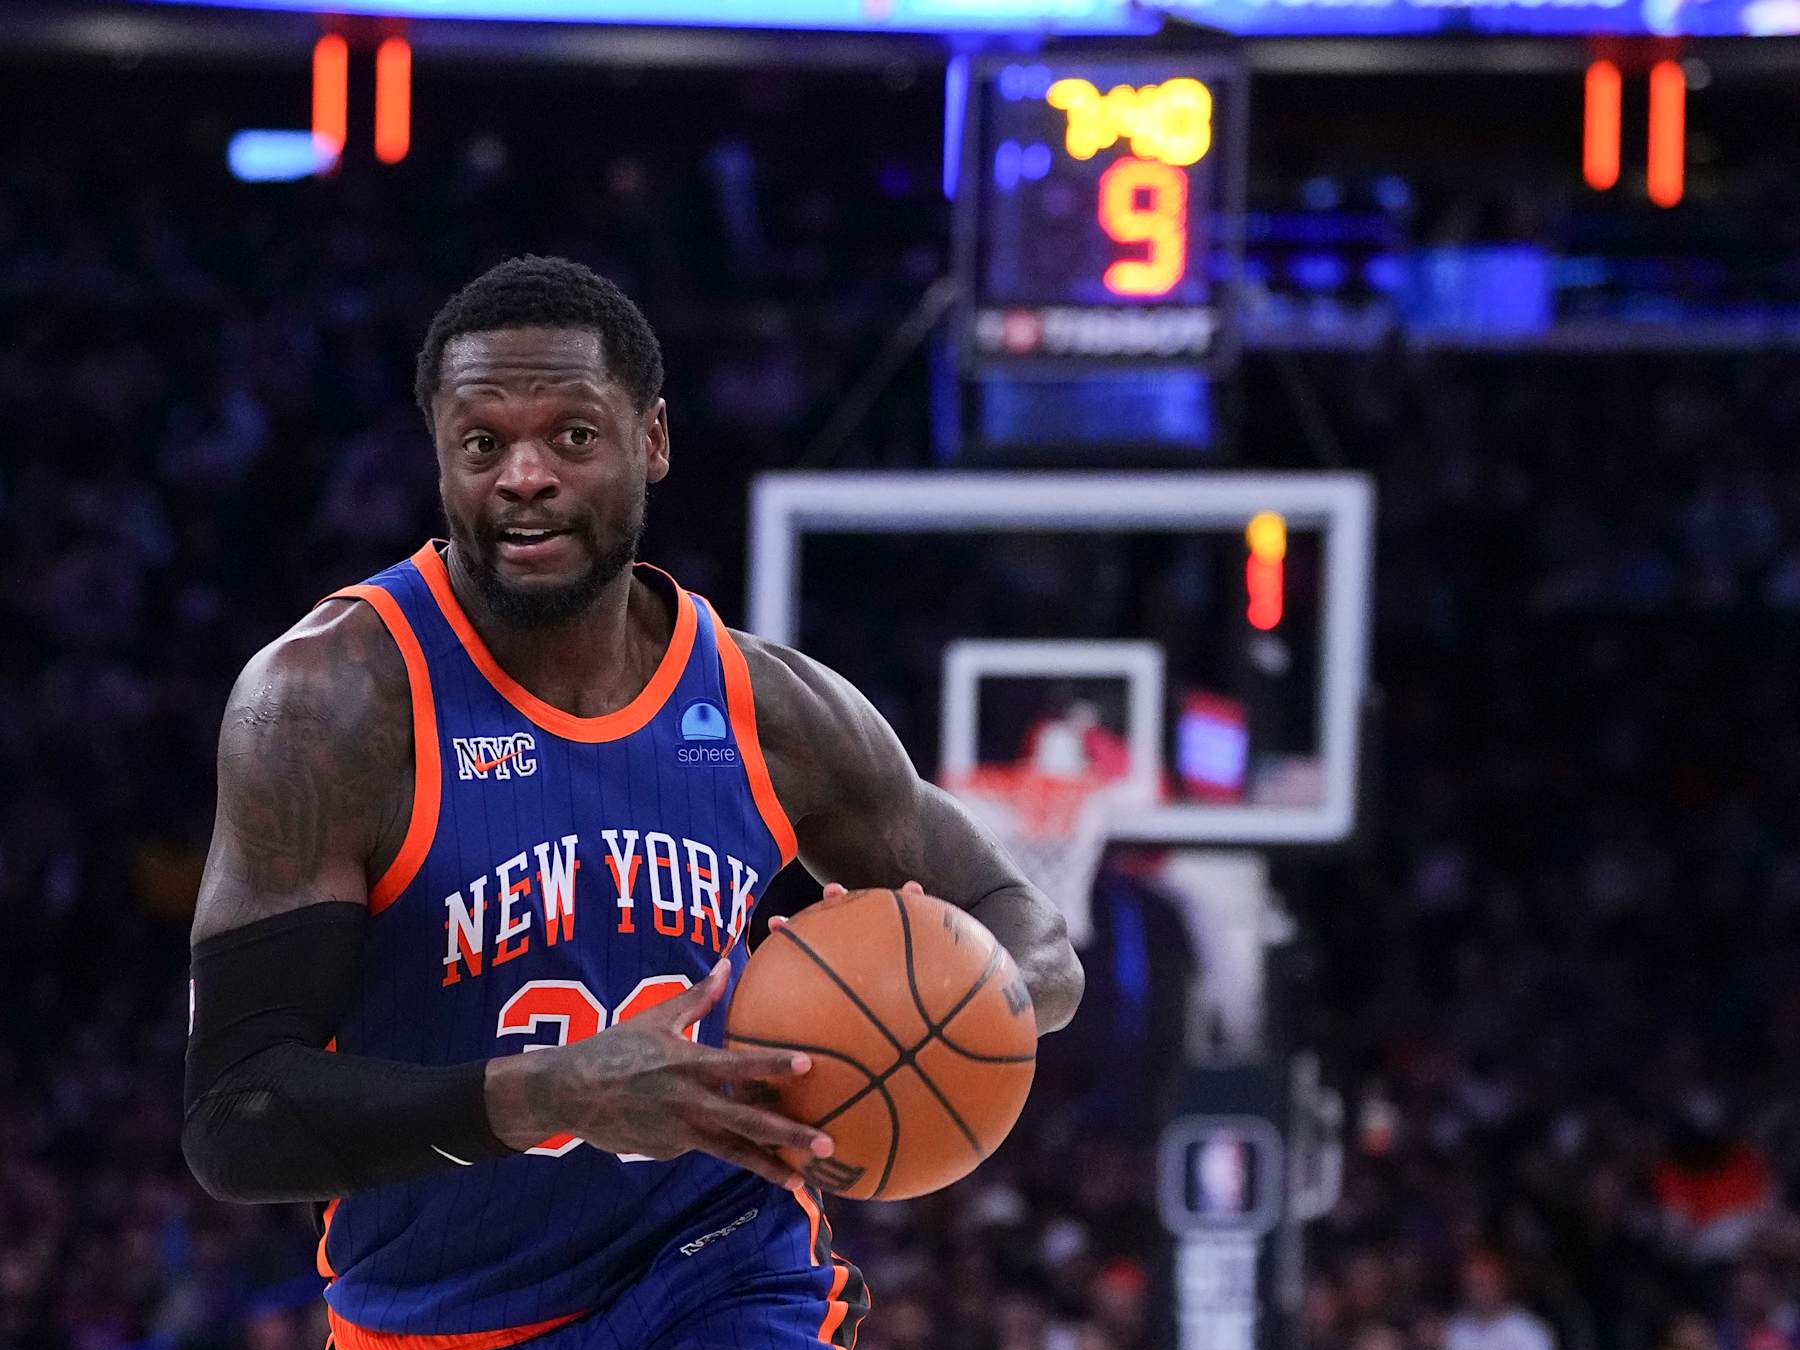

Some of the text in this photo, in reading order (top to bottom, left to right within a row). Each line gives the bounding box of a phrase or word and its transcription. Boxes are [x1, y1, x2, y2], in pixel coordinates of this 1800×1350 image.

[1098, 156, 1189, 297] 9
[452, 732, 537, 780] NYC
[677, 745, 736, 763] sphere
[442, 829, 759, 987] NEW YORK
